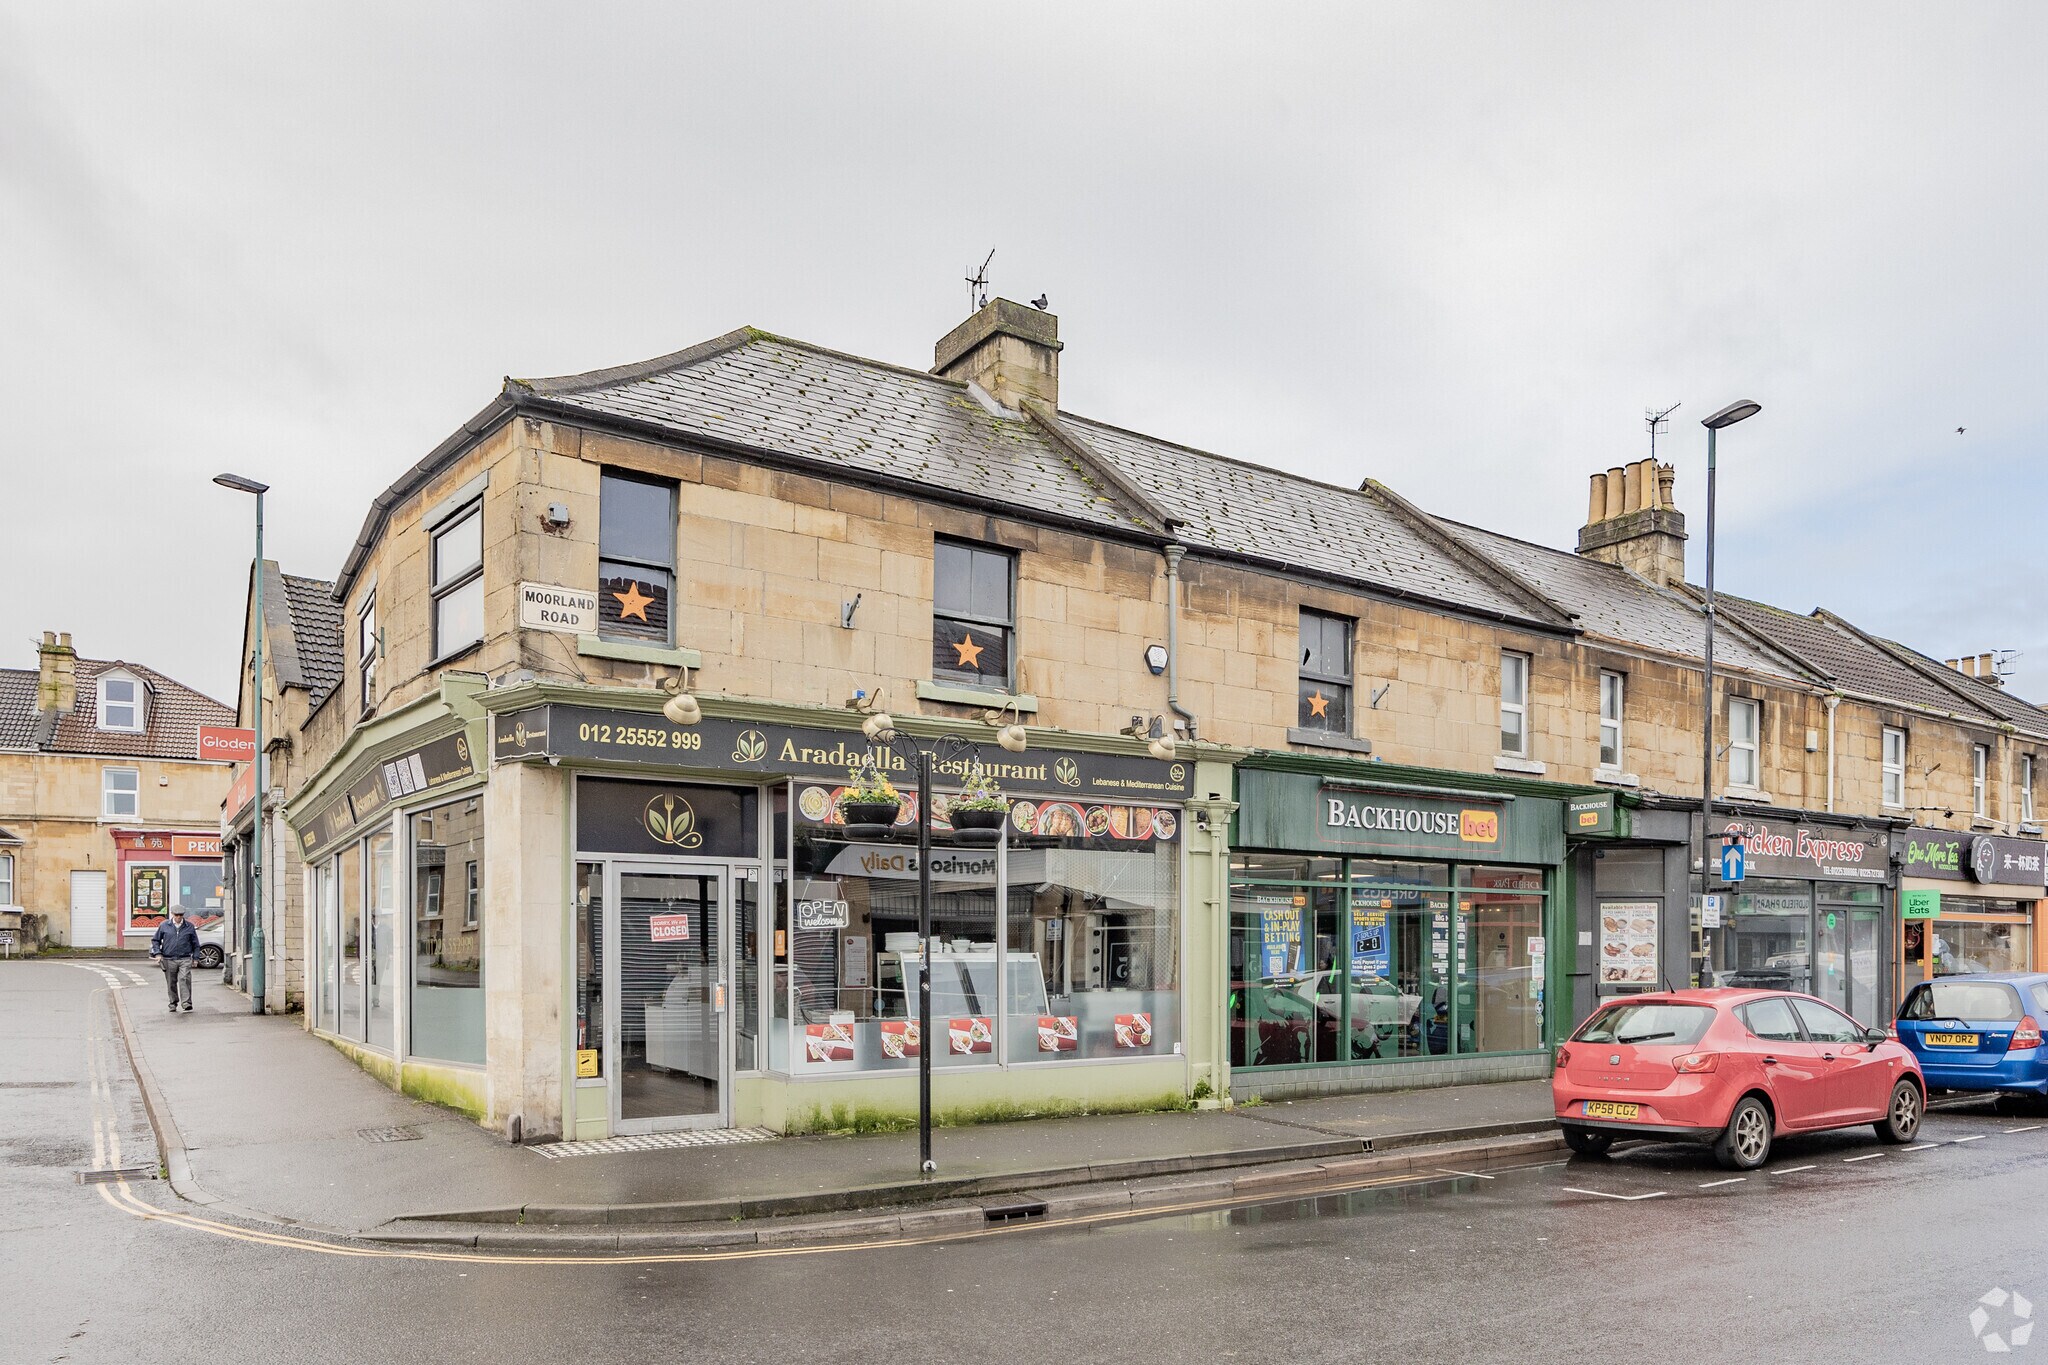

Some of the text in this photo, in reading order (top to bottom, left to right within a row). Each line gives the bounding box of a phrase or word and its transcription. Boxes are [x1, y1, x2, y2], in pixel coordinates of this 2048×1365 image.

[525, 590, 595, 610] MOORLAND
[540, 609, 580, 625] ROAD
[202, 735, 255, 750] Gloden
[579, 723, 701, 750] 012 25552 999
[778, 738, 907, 772] Aradaella
[1092, 777, 1185, 791] Lebanese & Mediterranean Cuisine
[1570, 800, 1608, 811] BACKHOUSE
[1327, 798, 1496, 838] BACKHOUSE bet
[1580, 813, 1597, 824] bet
[188, 841, 222, 852] PEKI
[1796, 829, 1865, 867] Express
[1907, 840, 1925, 864] One
[1924, 841, 1947, 869] More
[1946, 841, 1959, 864] Tea
[1257, 896, 1305, 905] BACKHOUSE bet
[1429, 901, 1459, 909] BACKHE
[802, 900, 845, 917] OPEN
[1263, 909, 1300, 921] CASH OUT
[804, 914, 845, 927] welcome
[1264, 920, 1300, 932] & IN-PLAY
[653, 925, 687, 937] CLOSED
[1264, 932, 1300, 943] BETTING
[1929, 1034, 1974, 1044] VN07 ORZ
[1588, 1102, 1637, 1116] KP58 CGZ
